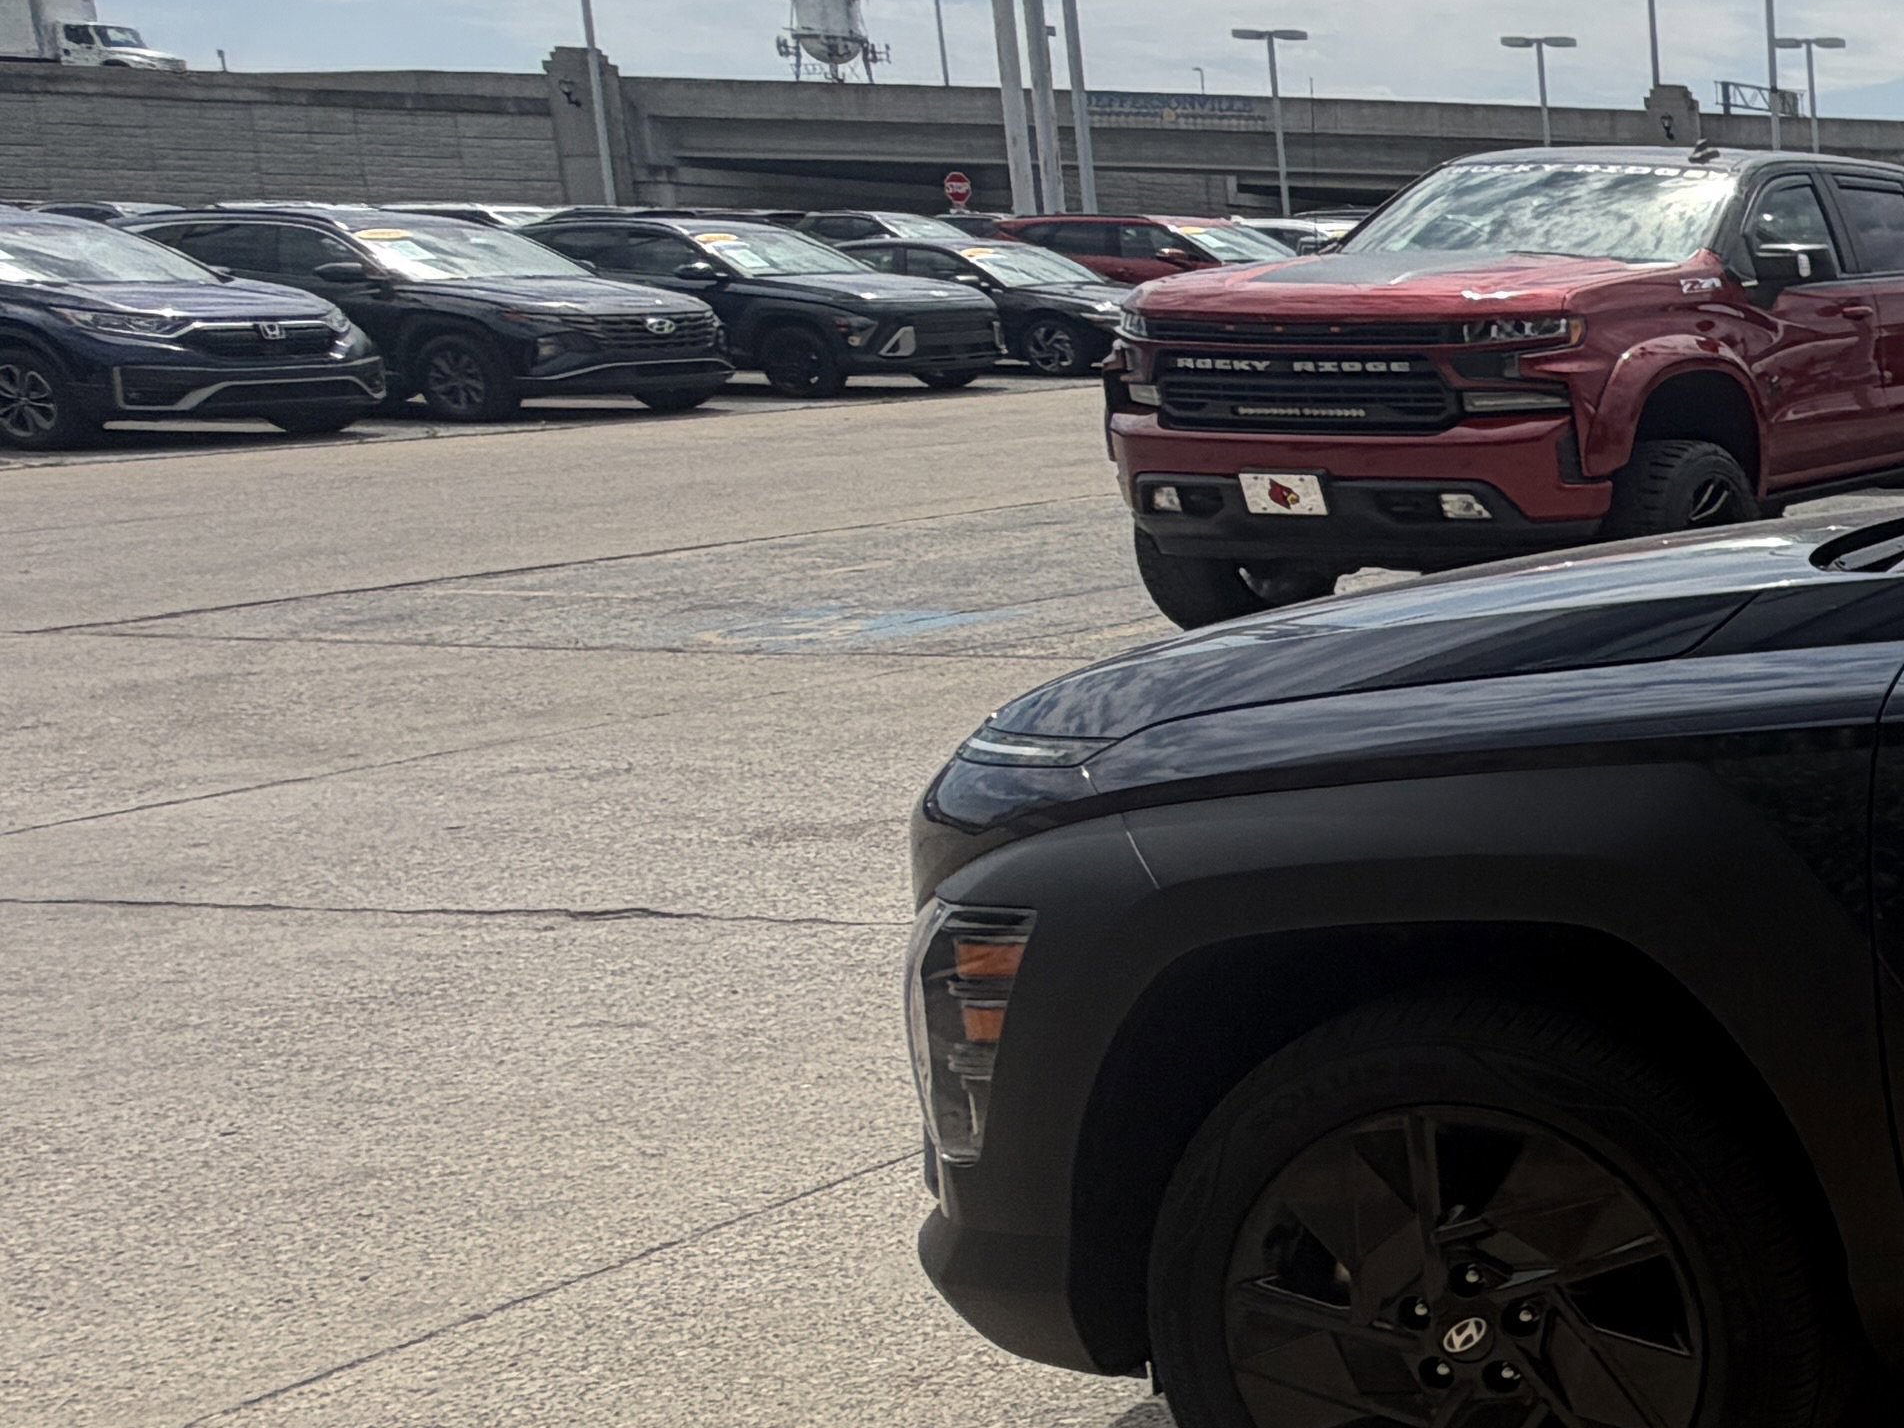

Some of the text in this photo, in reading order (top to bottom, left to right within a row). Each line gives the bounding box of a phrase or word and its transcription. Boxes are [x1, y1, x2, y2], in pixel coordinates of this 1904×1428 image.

[945, 181, 970, 194] STOP
[1176, 357, 1411, 372] ROCKY RIDGE
